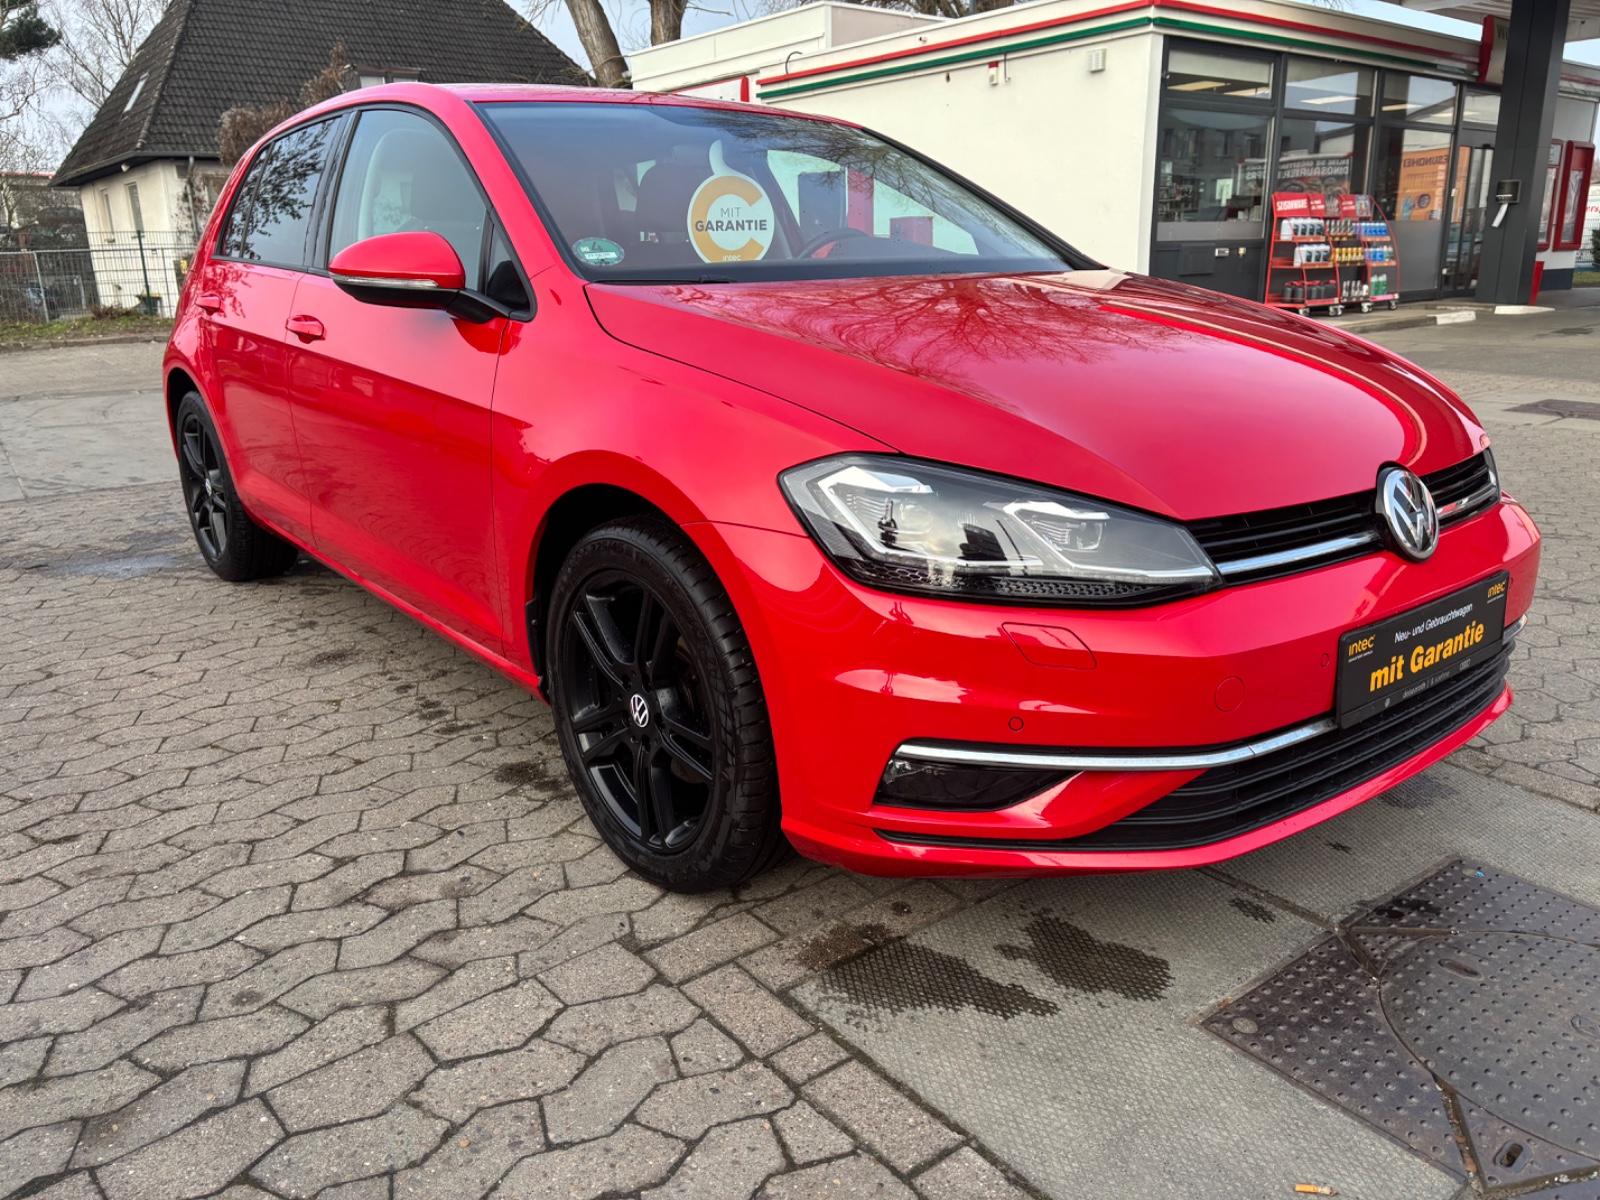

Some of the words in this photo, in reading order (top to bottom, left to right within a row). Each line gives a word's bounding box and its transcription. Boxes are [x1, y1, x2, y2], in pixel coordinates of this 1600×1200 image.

[720, 207, 742, 218] MIT
[695, 220, 768, 232] GARANTIE
[1394, 630, 1412, 644] Neu-
[1412, 622, 1425, 636] und
[1425, 603, 1473, 631] Gebrauchtwagen
[1369, 655, 1405, 692] mit
[1410, 620, 1485, 675] Garantie
